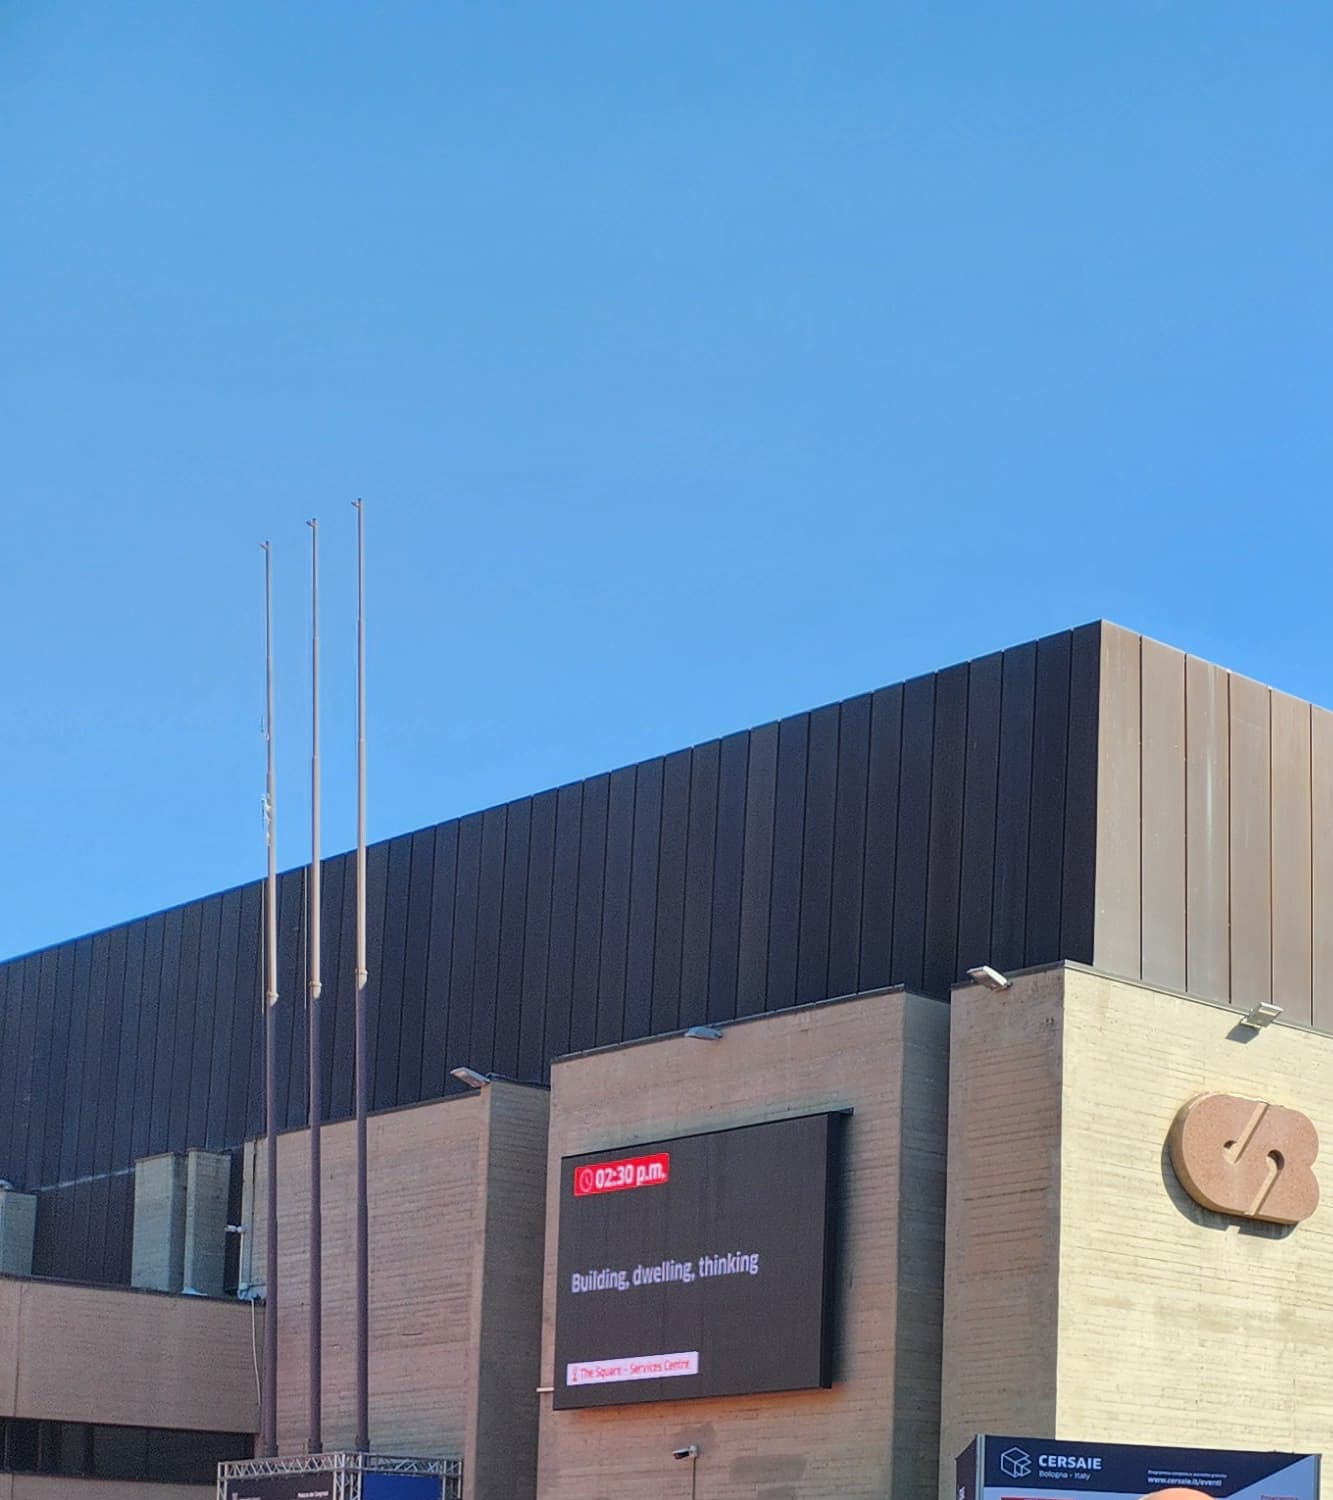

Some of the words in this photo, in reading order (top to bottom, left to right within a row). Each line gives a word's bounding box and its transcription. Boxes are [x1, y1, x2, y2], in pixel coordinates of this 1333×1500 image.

[595, 1166, 634, 1189] 02:30
[636, 1161, 666, 1187] p.m.
[571, 1268, 629, 1293] Building,
[632, 1259, 695, 1286] dwelling,
[698, 1250, 760, 1278] thinking
[580, 1366, 593, 1379] The
[630, 1360, 662, 1374] Services
[1038, 1455, 1103, 1470] CERSAIE
[1038, 1470, 1068, 1480] Bologna
[1074, 1472, 1091, 1480] Italy
